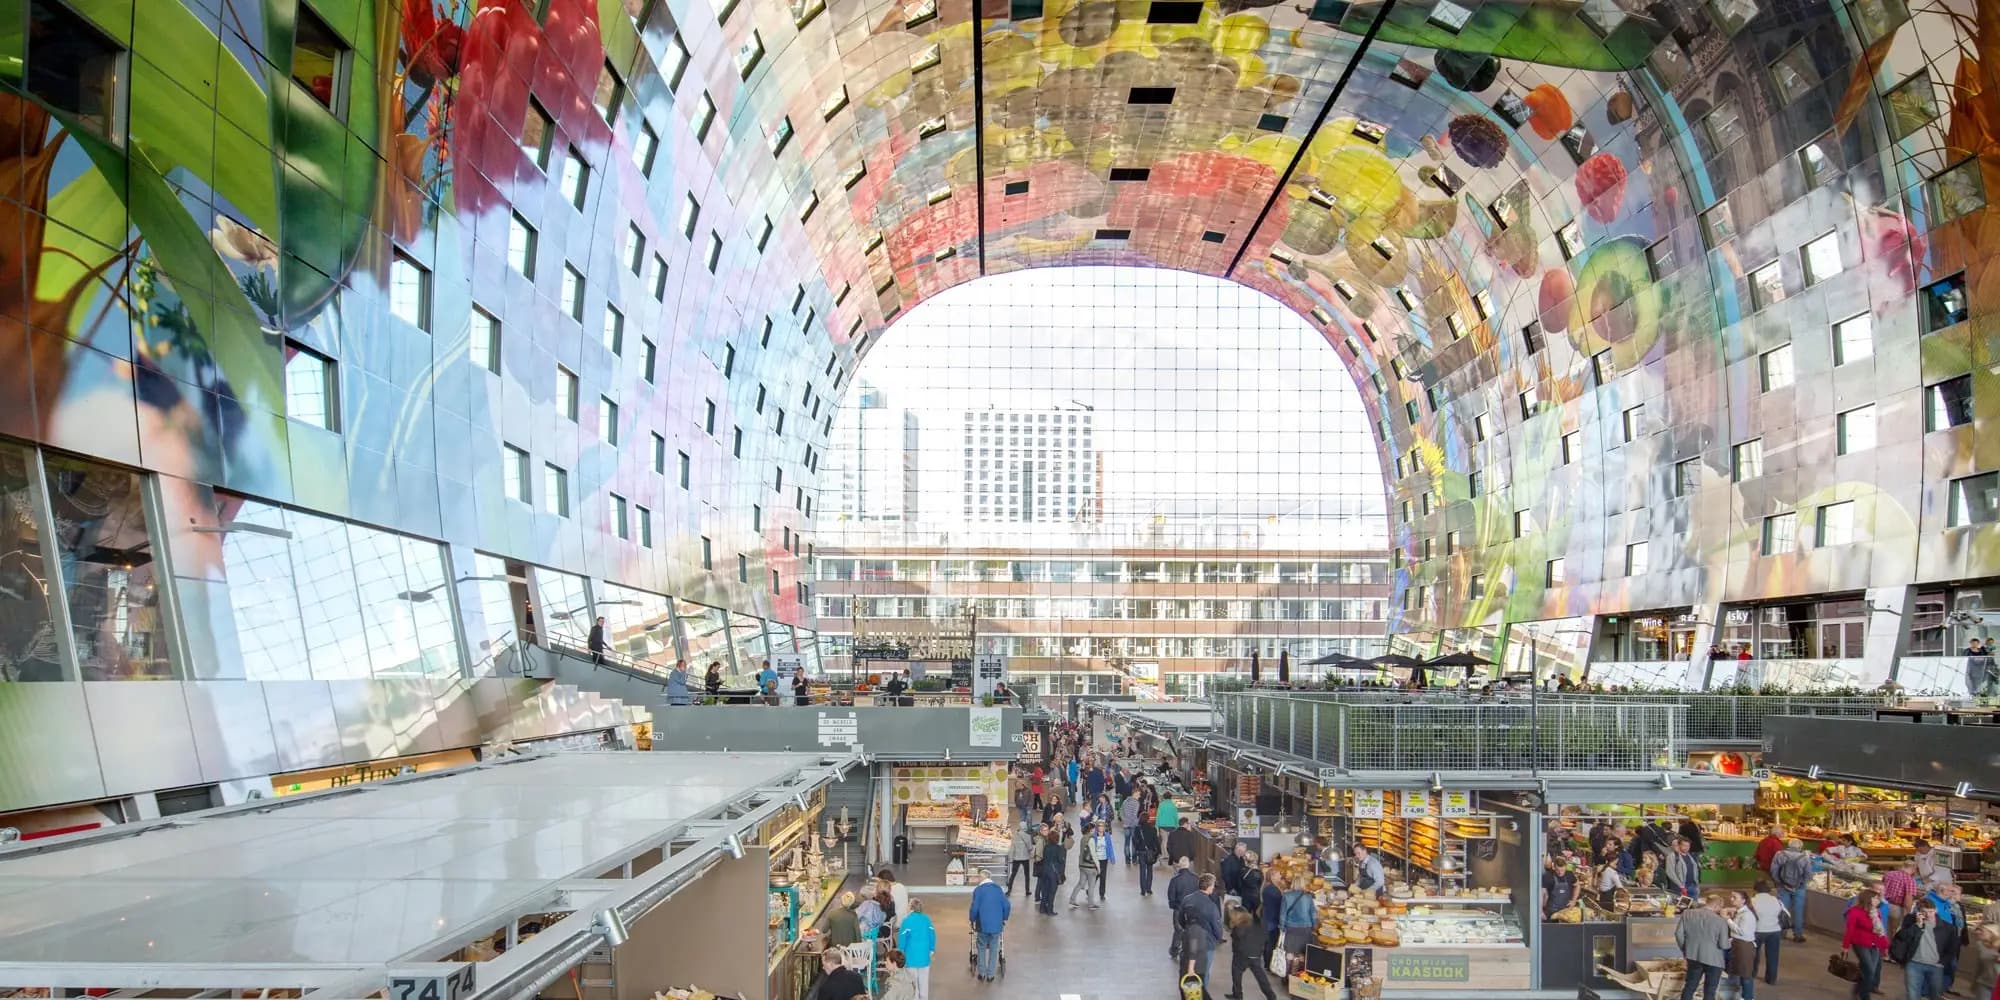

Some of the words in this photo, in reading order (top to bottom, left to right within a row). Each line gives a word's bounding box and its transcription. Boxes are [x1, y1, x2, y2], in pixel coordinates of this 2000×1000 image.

[1642, 617, 1662, 628] Wine
[1320, 768, 1336, 777] 48
[393, 979, 441, 1000] 74
[447, 966, 474, 1000] 74
